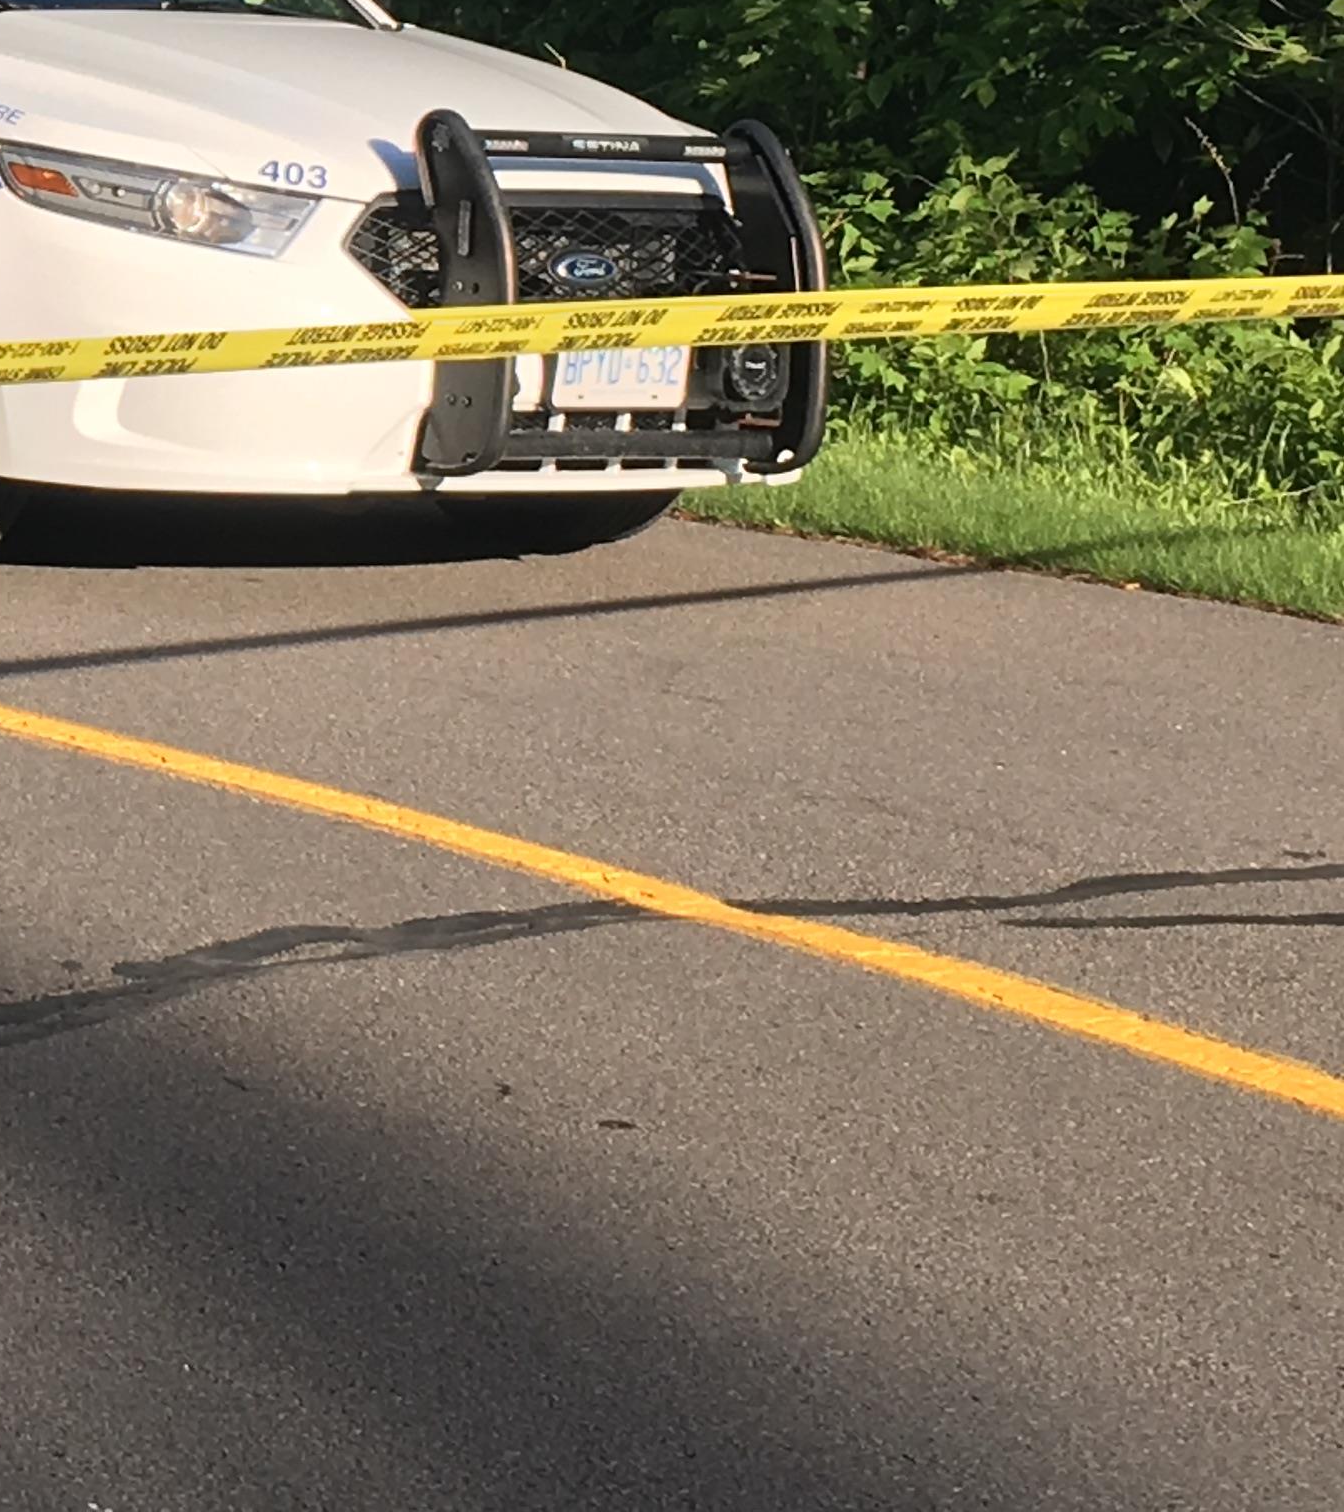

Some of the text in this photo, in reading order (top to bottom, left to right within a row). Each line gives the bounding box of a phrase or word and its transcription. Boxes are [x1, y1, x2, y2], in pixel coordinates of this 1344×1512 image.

[258, 159, 328, 189] 403
[161, 333, 200, 353] NOT
[196, 331, 229, 351] DO
